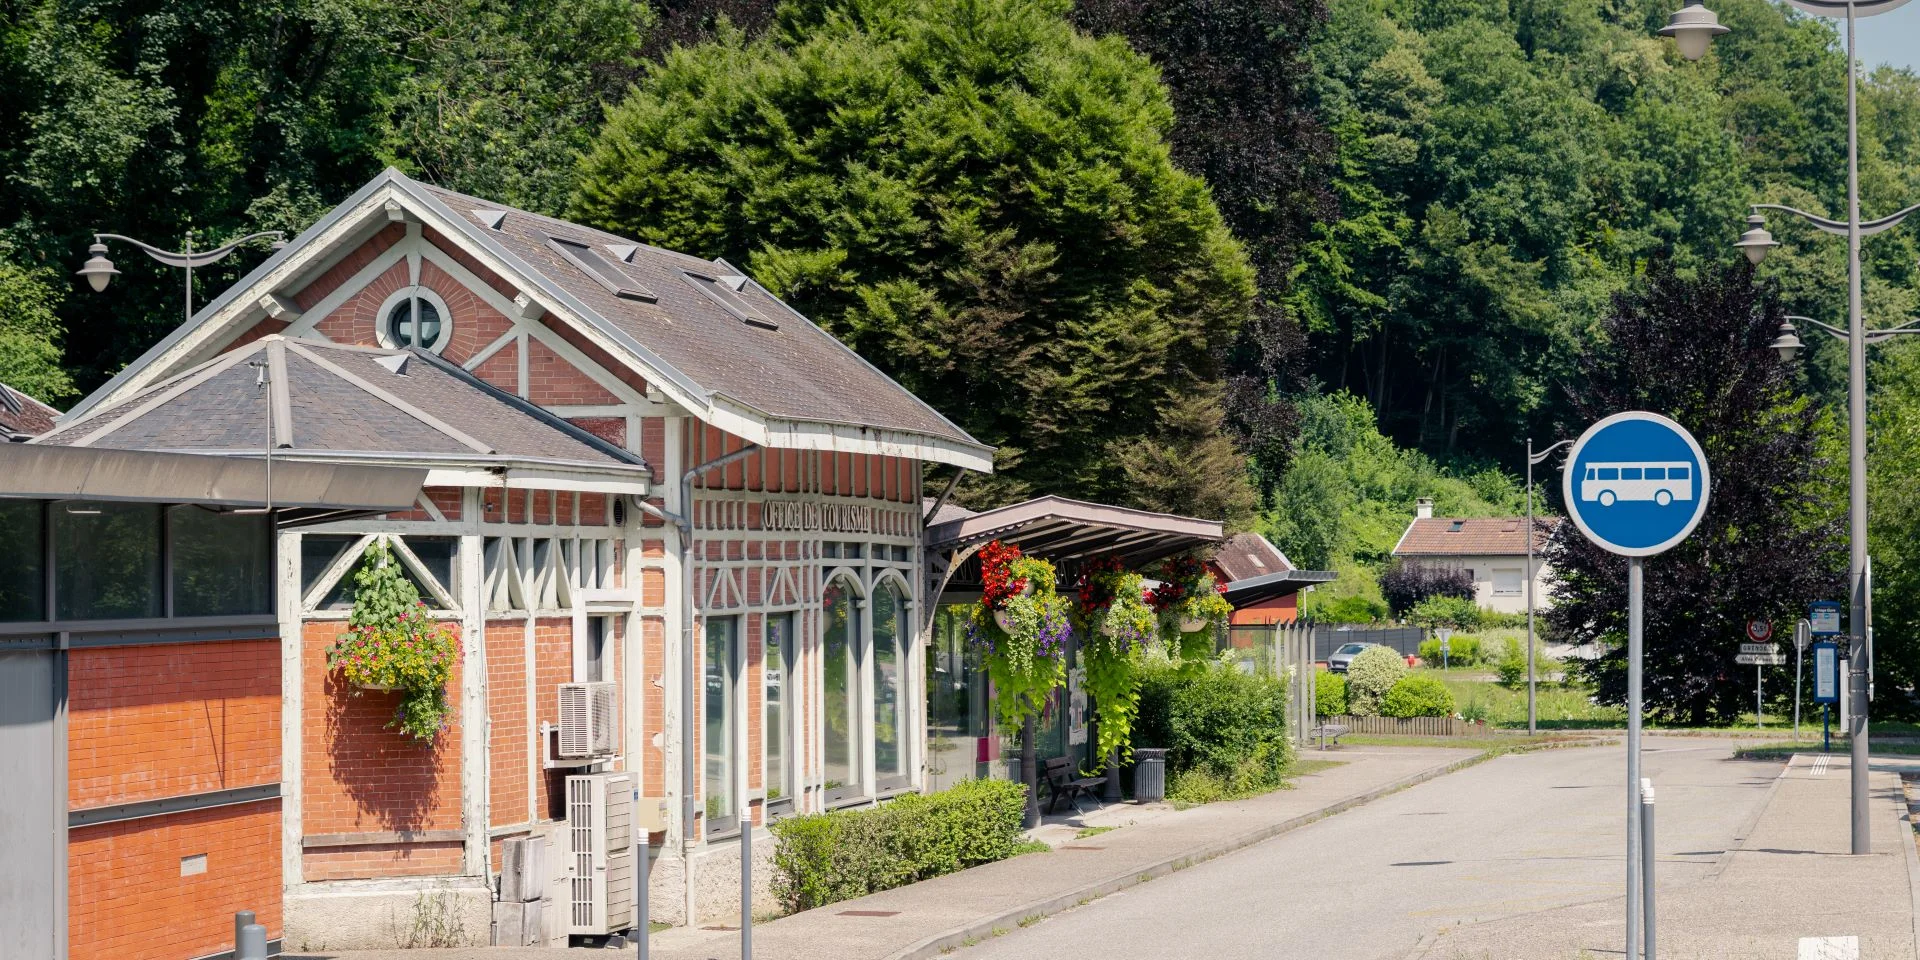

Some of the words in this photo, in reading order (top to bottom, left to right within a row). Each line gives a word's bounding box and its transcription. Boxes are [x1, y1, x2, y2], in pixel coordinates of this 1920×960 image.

[764, 501, 800, 529] OFFICE
[804, 502, 818, 529] DE
[821, 503, 869, 532] TOURISME
